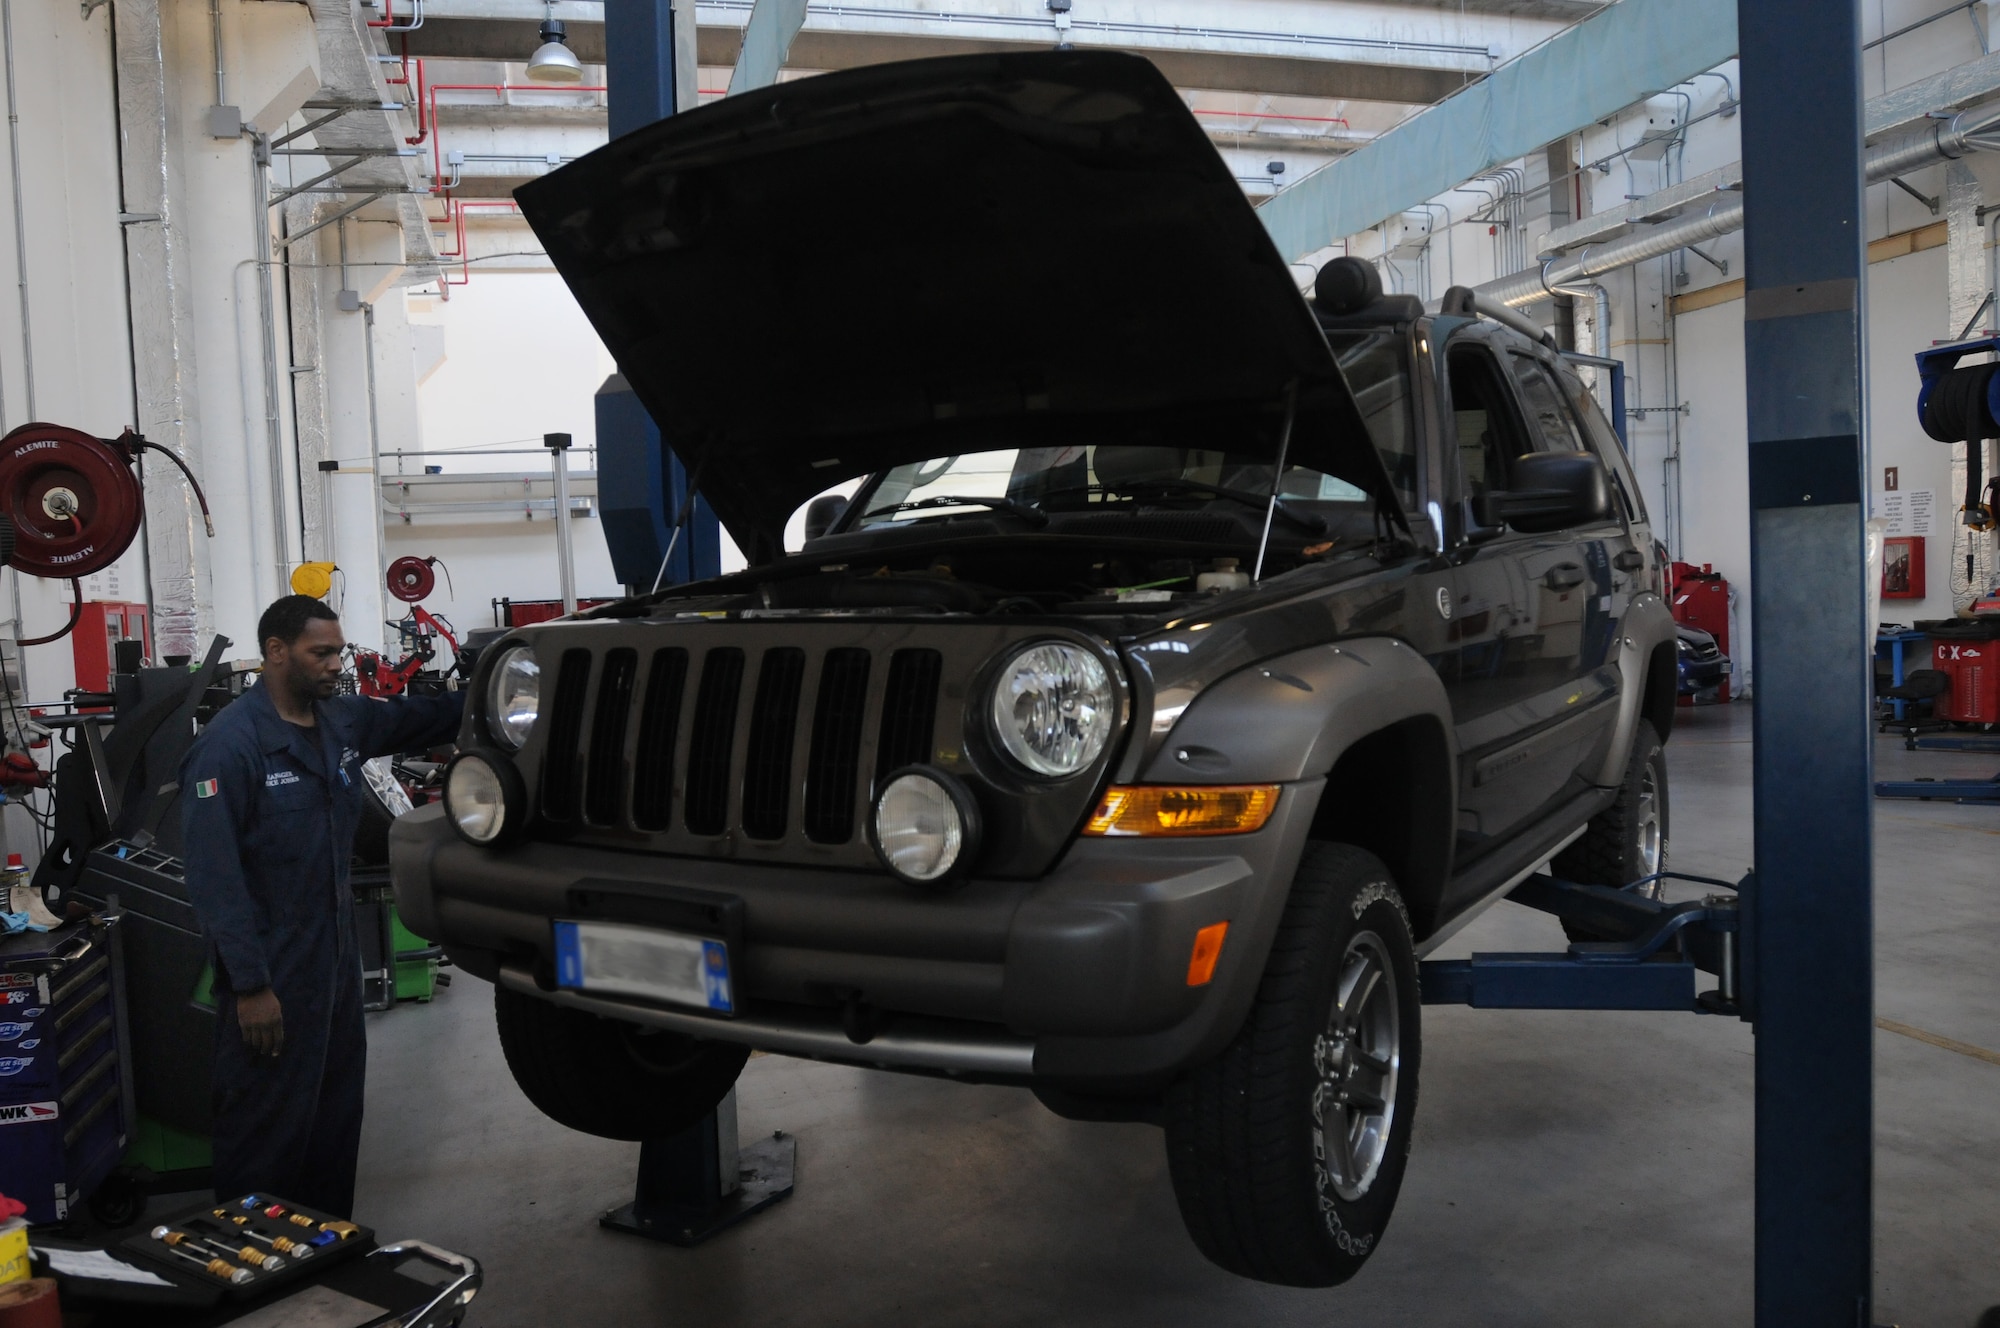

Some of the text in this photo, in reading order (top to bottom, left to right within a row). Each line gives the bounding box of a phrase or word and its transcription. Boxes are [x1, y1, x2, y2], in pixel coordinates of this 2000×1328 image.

[14, 440, 59, 458] ALEMITE
[1887, 471, 1894, 487] 1
[50, 545, 94, 563] ALEMITE
[0, 1106, 28, 1119] WK
